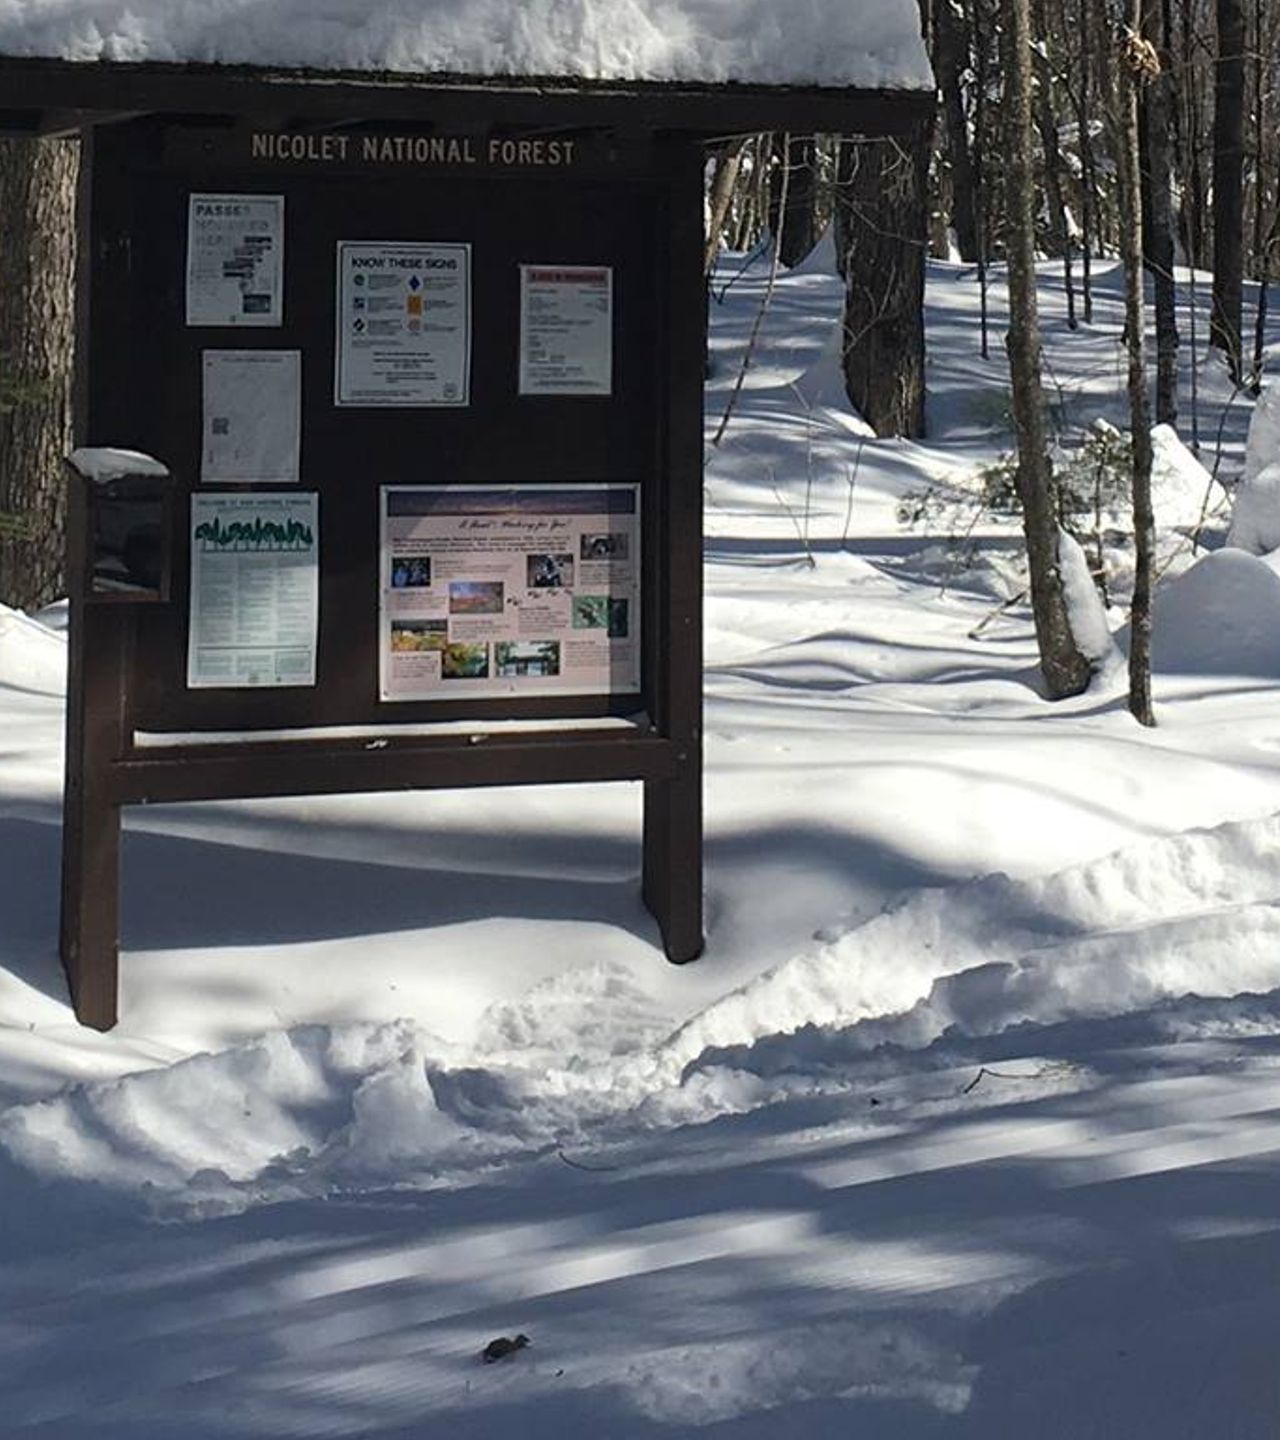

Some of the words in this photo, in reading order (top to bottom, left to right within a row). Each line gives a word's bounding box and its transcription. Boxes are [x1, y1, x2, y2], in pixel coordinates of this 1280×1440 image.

[251, 134, 349, 159] NICOLET
[363, 137, 476, 162] NATIONAL
[489, 140, 574, 165] FOREST
[351, 256, 385, 269] KNOW
[389, 257, 423, 269] THESE
[425, 258, 458, 270] SIGNS
